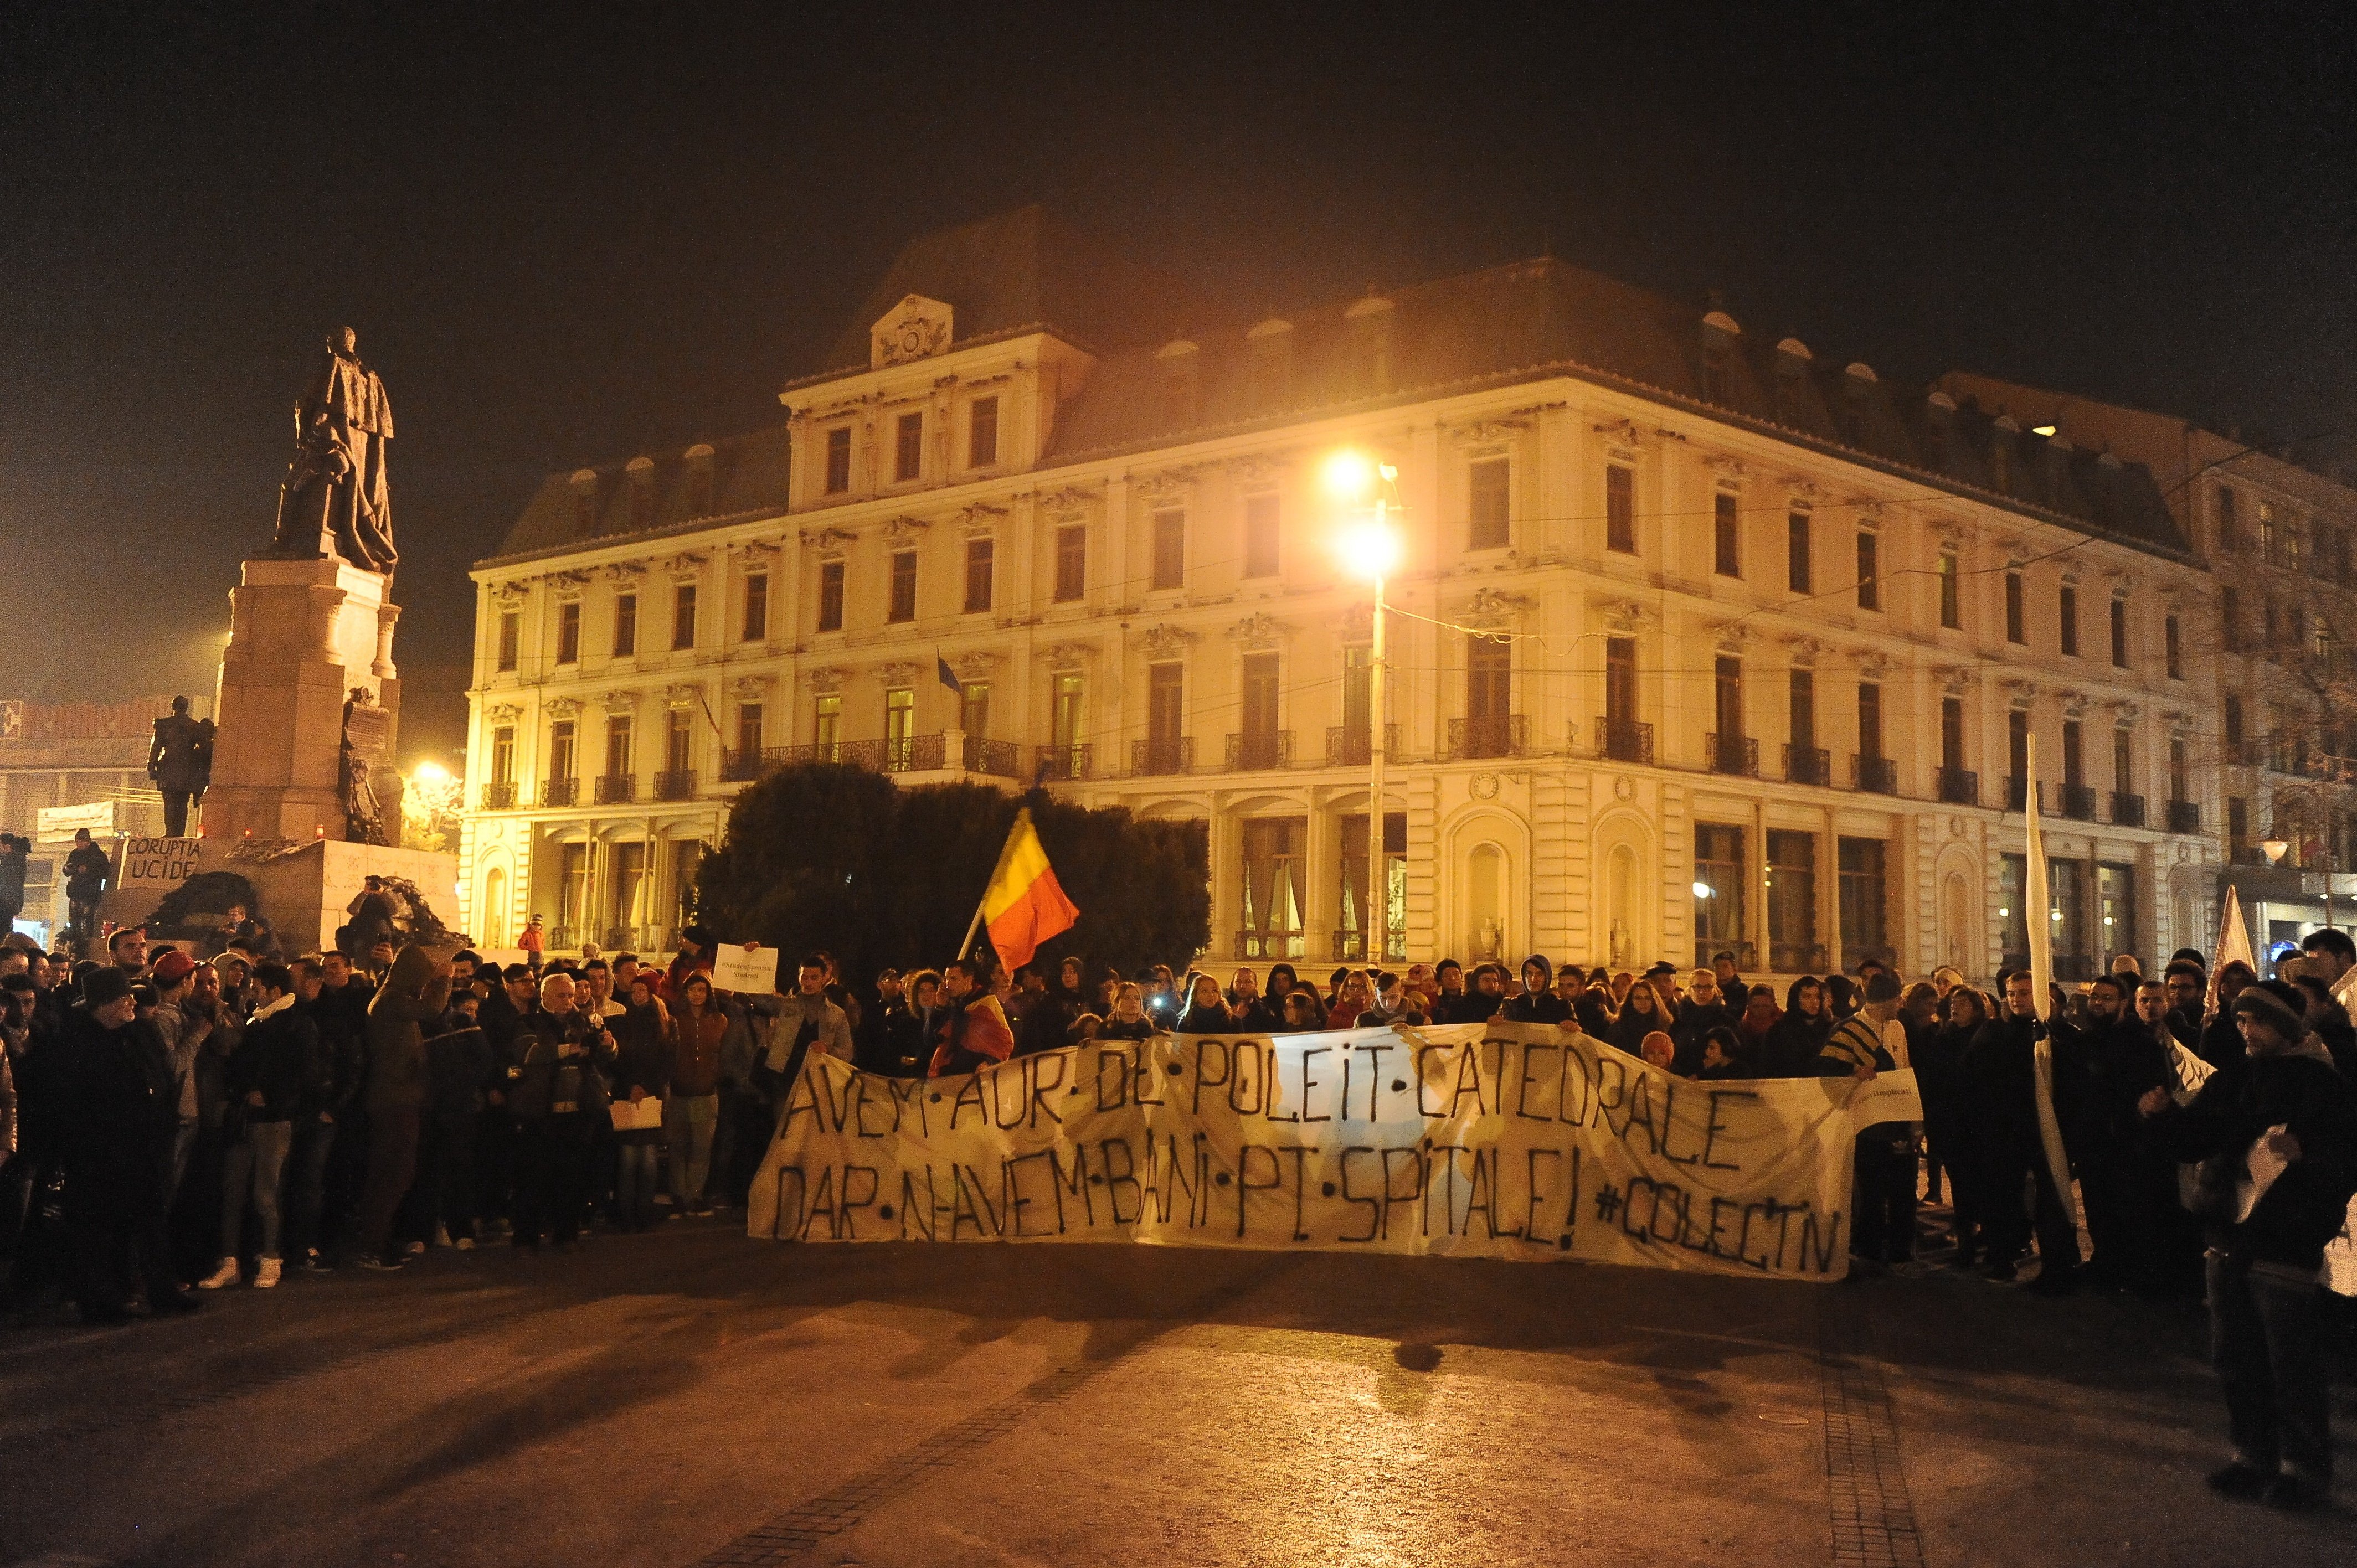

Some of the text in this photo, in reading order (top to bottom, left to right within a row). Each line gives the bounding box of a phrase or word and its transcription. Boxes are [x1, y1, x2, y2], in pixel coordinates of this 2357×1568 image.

[780, 1064, 929, 1139] AVEM
[950, 1051, 1068, 1130] AUR
[1095, 1044, 1164, 1113] DE
[1417, 1038, 1758, 1171] CATEDRALE
[775, 1164, 879, 1242] DAR
